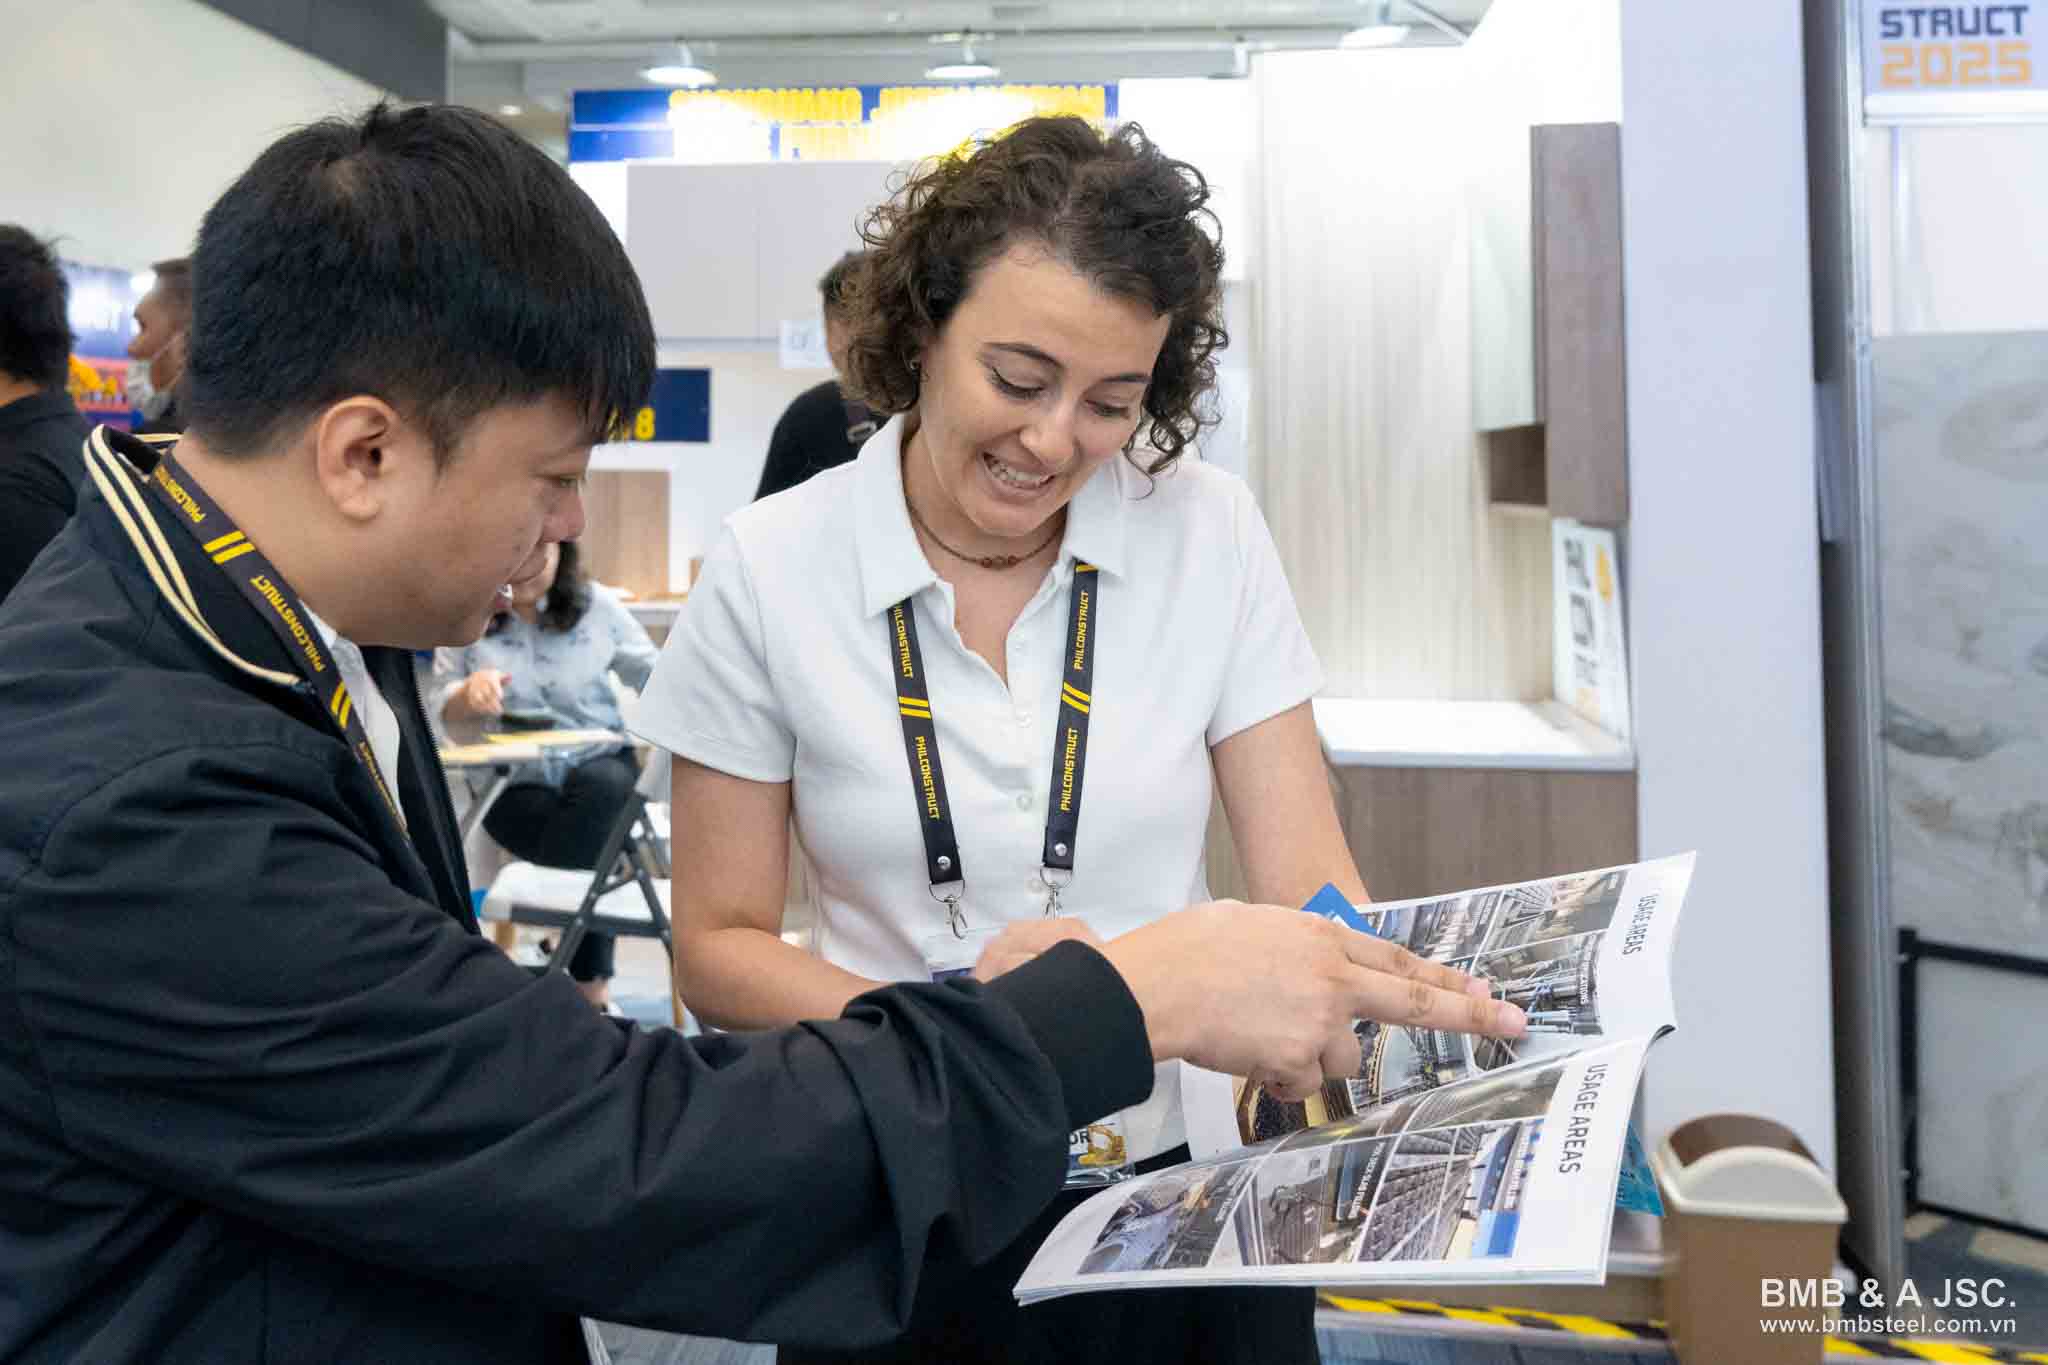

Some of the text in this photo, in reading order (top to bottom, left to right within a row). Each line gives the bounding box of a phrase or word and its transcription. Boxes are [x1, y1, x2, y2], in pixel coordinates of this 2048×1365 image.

[1880, 5, 2029, 38] STRUCT
[1880, 42, 2033, 87] 2025
[249, 574, 327, 673] PHILCONSTRUCT
[894, 605, 915, 679] HILCONSTRUCT
[1073, 591, 1090, 671] PHILCONSTRUCT
[915, 736, 941, 820] PHILCONSTRUCT
[1059, 727, 1079, 812] PHILCONSTRUCT
[1621, 922, 1649, 955] AREAS
[1559, 1063, 1609, 1174] USAGE AREAS
